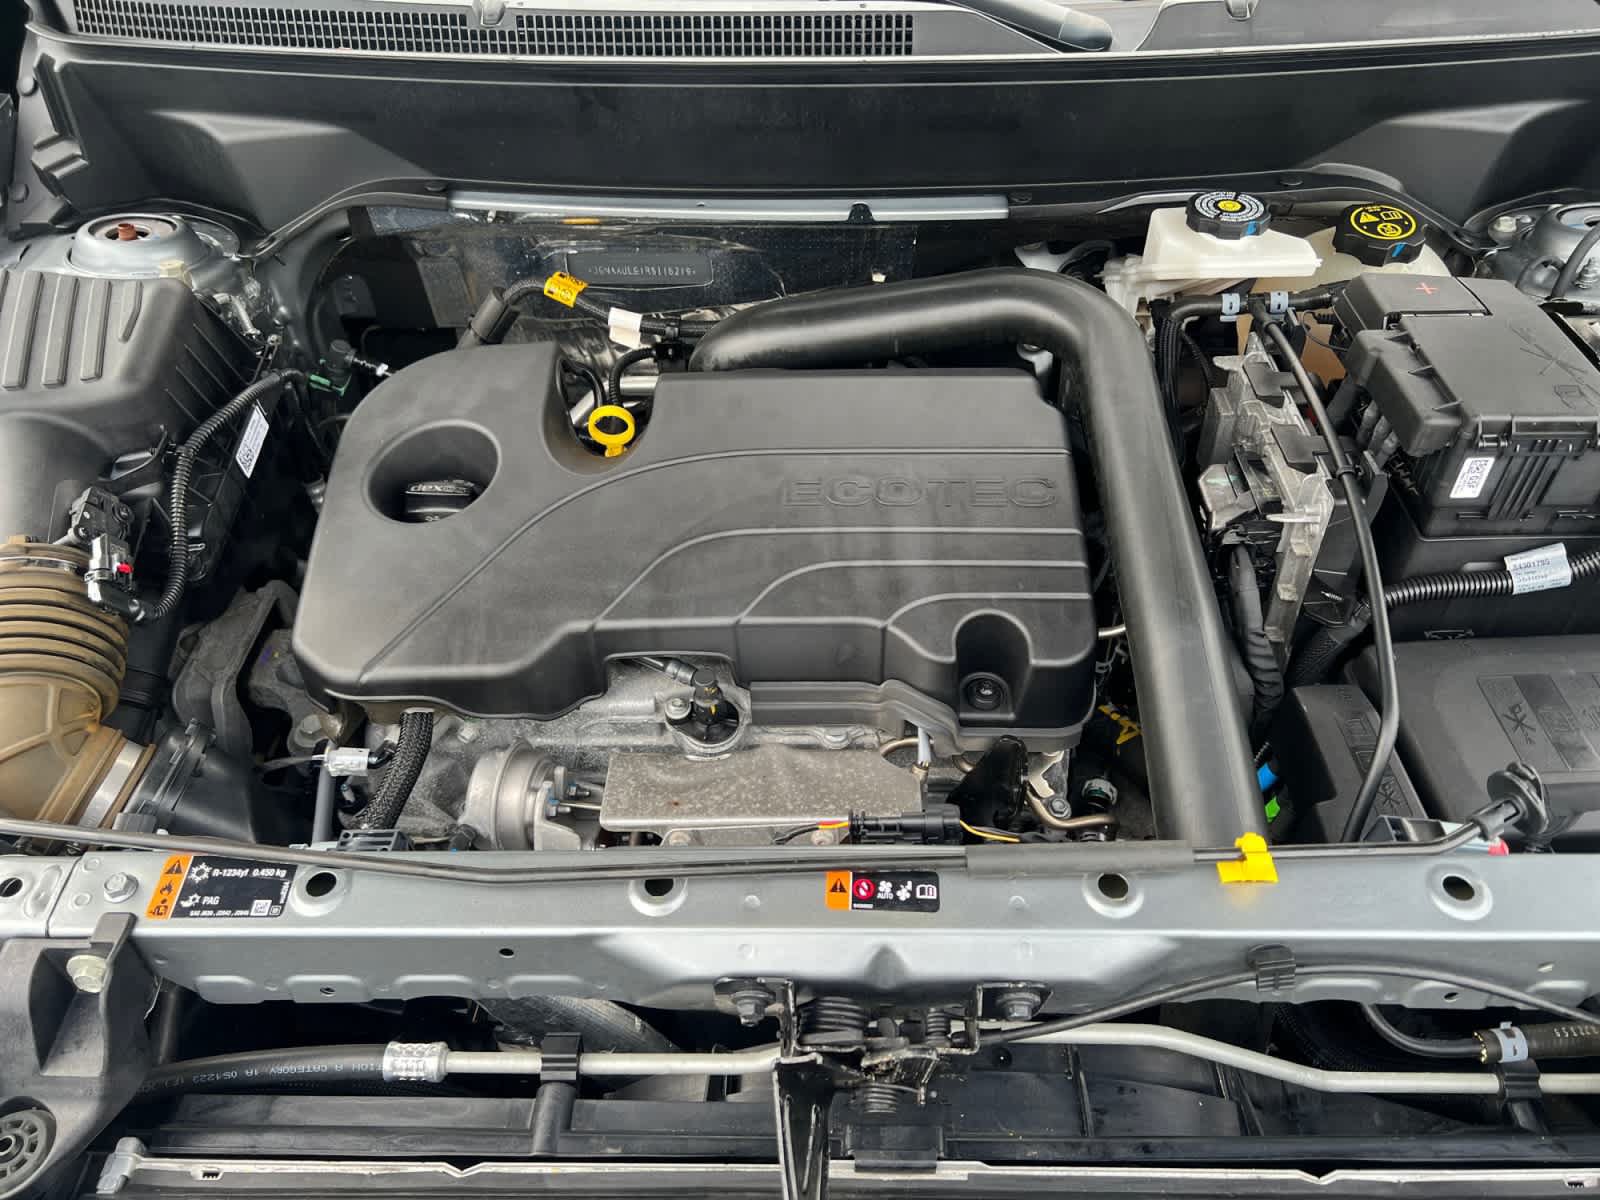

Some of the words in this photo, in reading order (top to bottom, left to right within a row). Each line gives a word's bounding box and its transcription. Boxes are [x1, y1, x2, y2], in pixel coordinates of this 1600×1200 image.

[783, 478, 1058, 508] ECOTEC
[212, 868, 249, 878] R-1234yf
[252, 868, 275, 877] 0.450
[276, 868, 287, 878] kg
[202, 896, 220, 905] PAG
